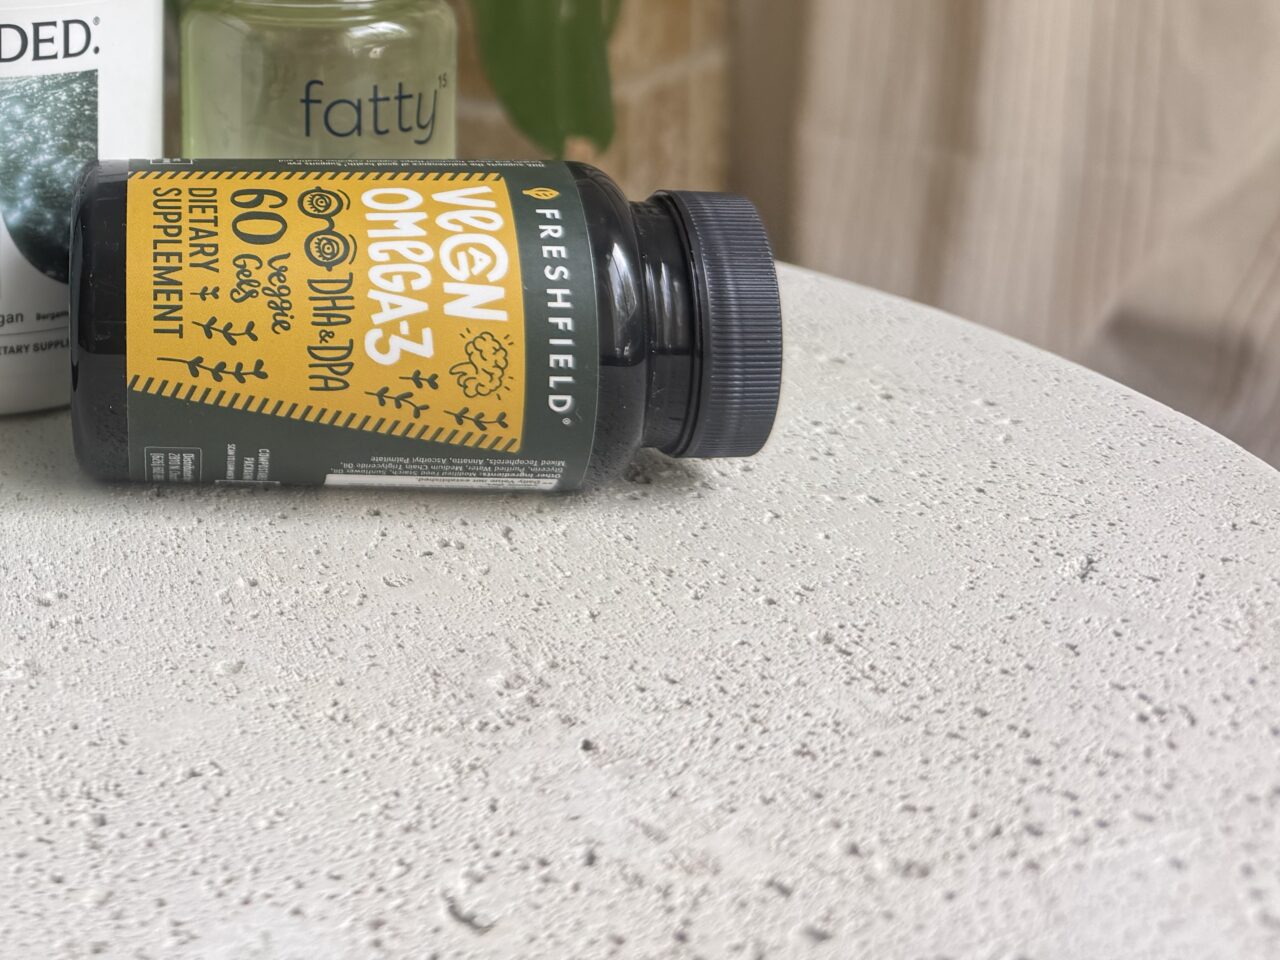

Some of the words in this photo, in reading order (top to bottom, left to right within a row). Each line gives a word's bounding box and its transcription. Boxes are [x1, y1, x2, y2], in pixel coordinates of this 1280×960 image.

[187, 186, 219, 274] DIETARY
[229, 187, 289, 246] 60
[151, 186, 185, 341] SUPPLEMENT
[230, 253, 262, 304] Gels
[32, 337, 69, 352] SUPPL
